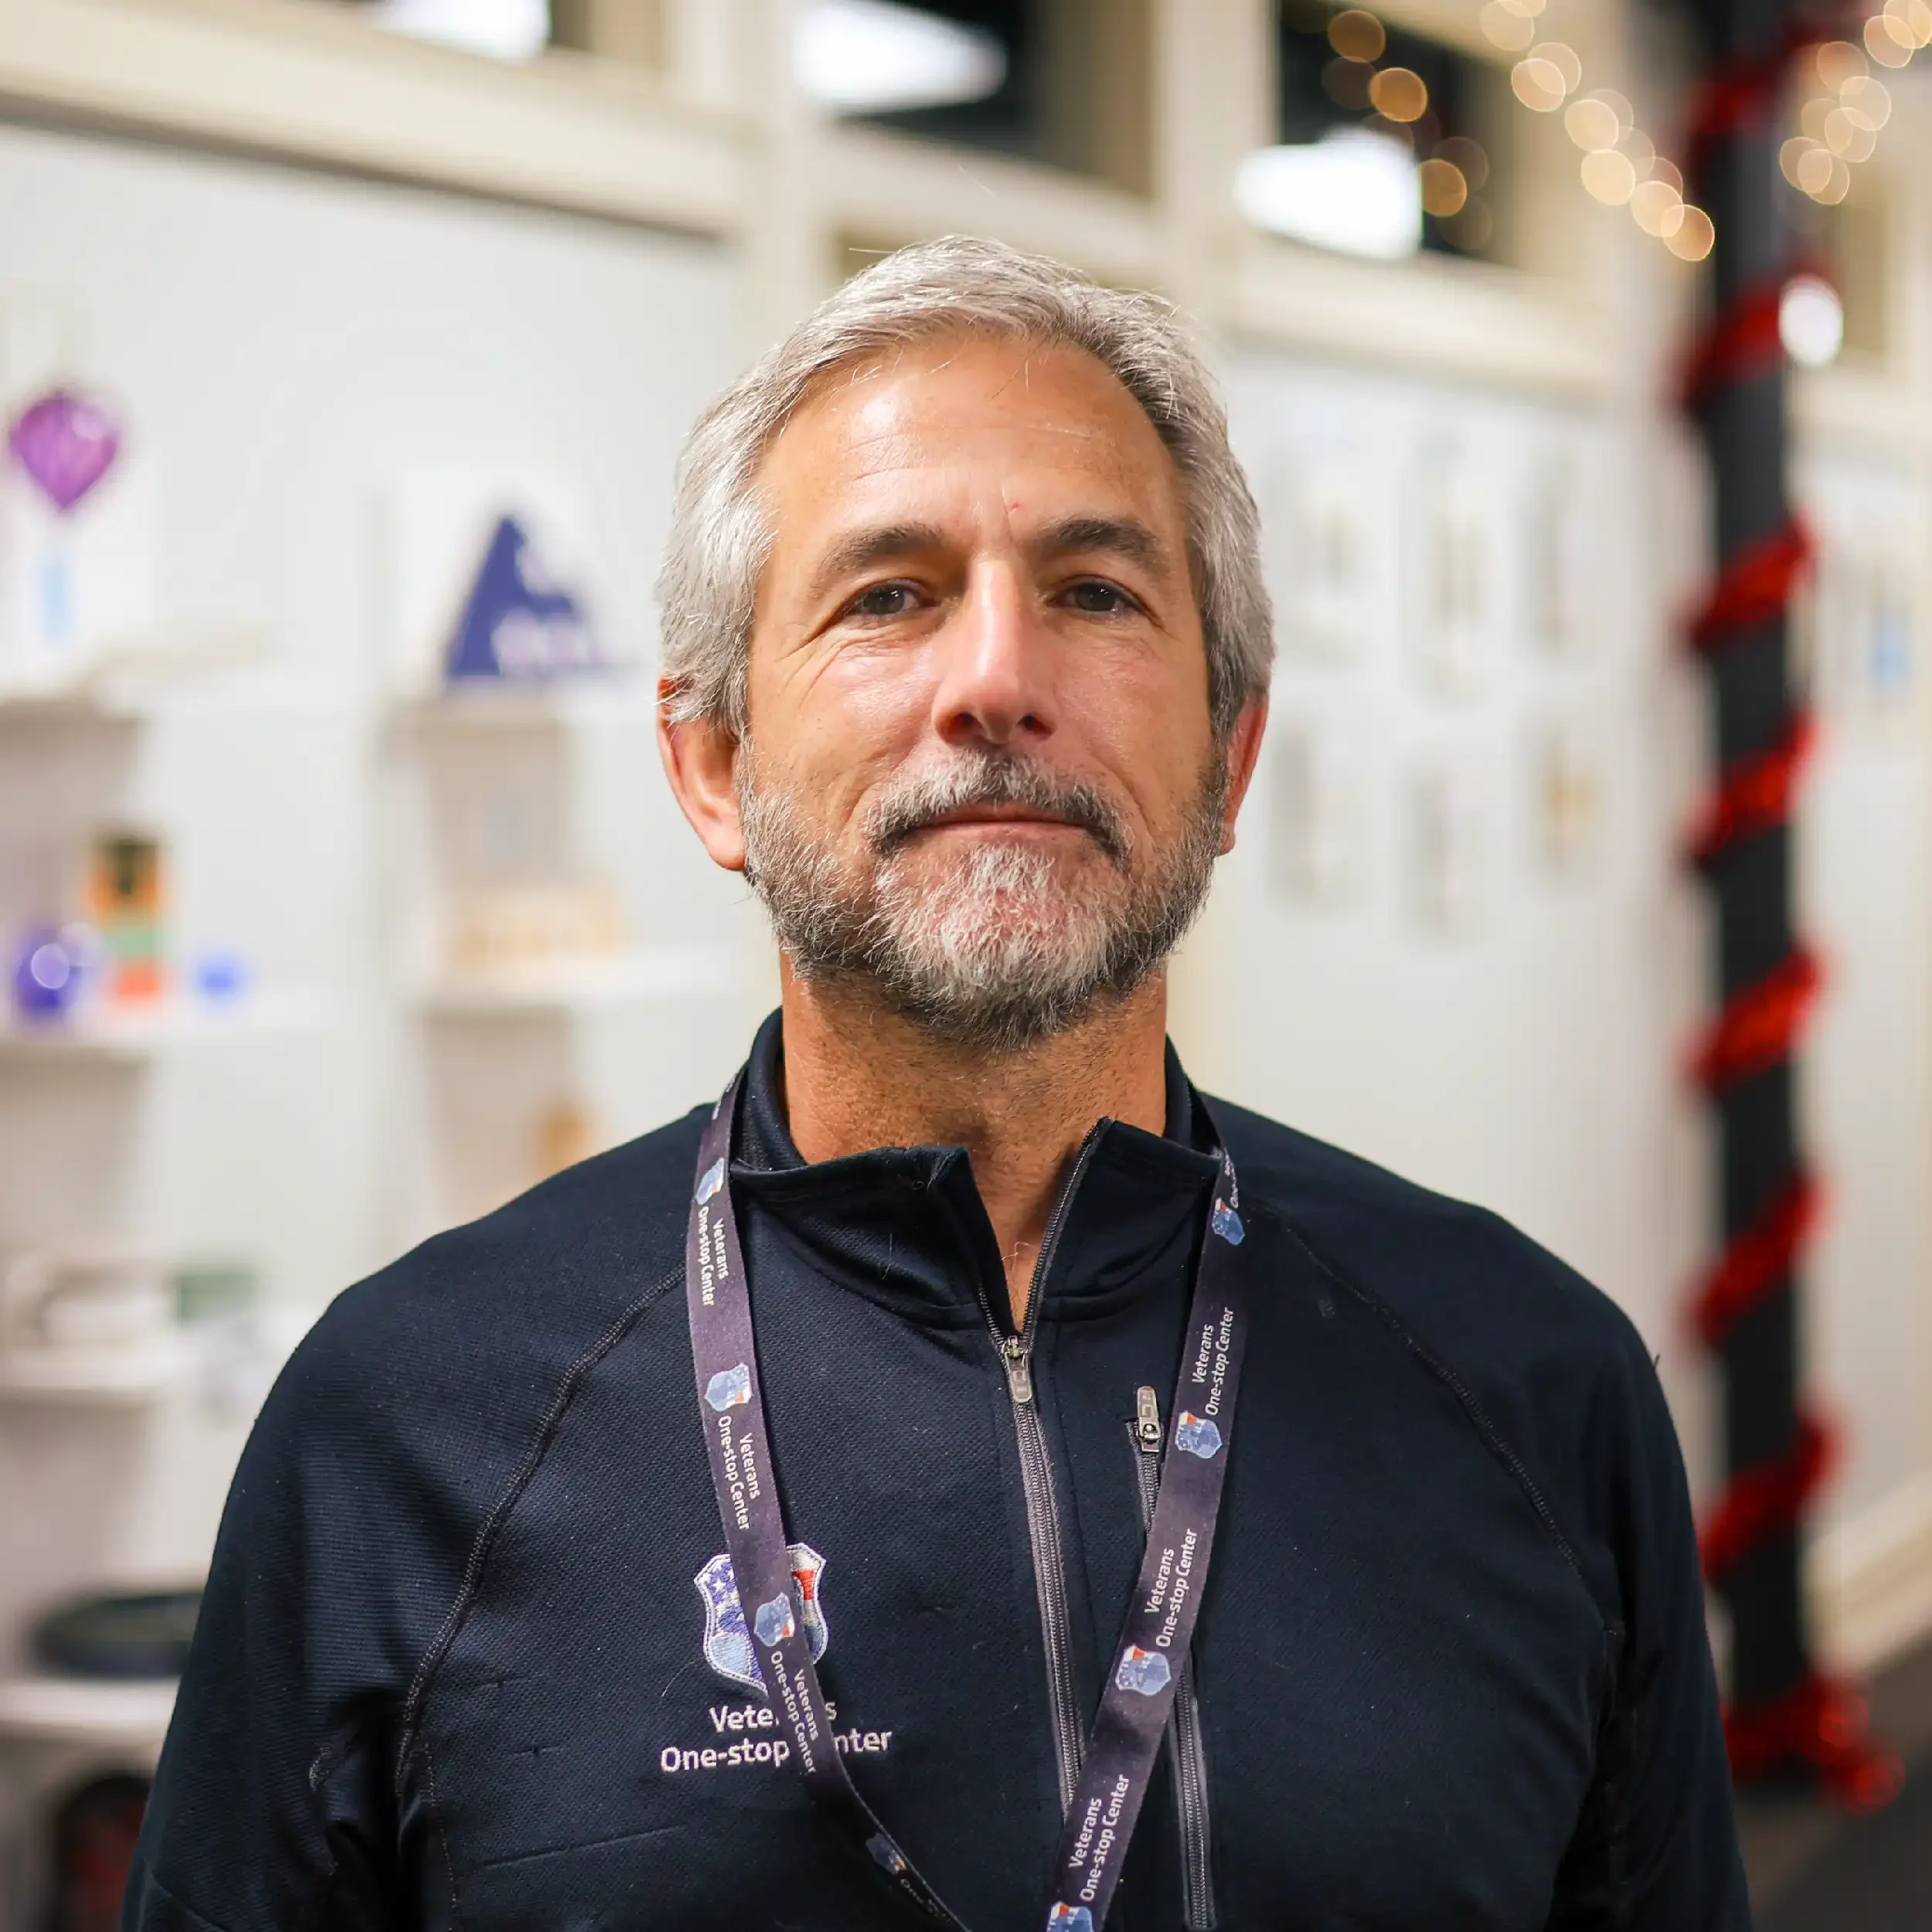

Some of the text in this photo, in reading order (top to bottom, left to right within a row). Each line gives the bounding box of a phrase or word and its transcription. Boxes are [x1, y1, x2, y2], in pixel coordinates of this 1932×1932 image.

[698, 1206, 716, 1306] One-stop Center
[713, 1217, 729, 1280] Veterans
[1192, 1323, 1214, 1384] Veterans
[1205, 1307, 1234, 1416] One-stop Center
[718, 1416, 750, 1531] One-stop Center
[739, 1433, 760, 1500] Veterans
[1145, 1547, 1175, 1614] Veterans
[1155, 1529, 1197, 1648] One-stop Center
[709, 1702, 838, 1733] Vetes
[771, 1650, 816, 1774] One-stop Center
[794, 1668, 819, 1741] Veterans
[661, 1727, 893, 1772] One-stop nter
[1069, 1797, 1102, 1868] Veterans
[1080, 1774, 1129, 1902] One-stop Center
